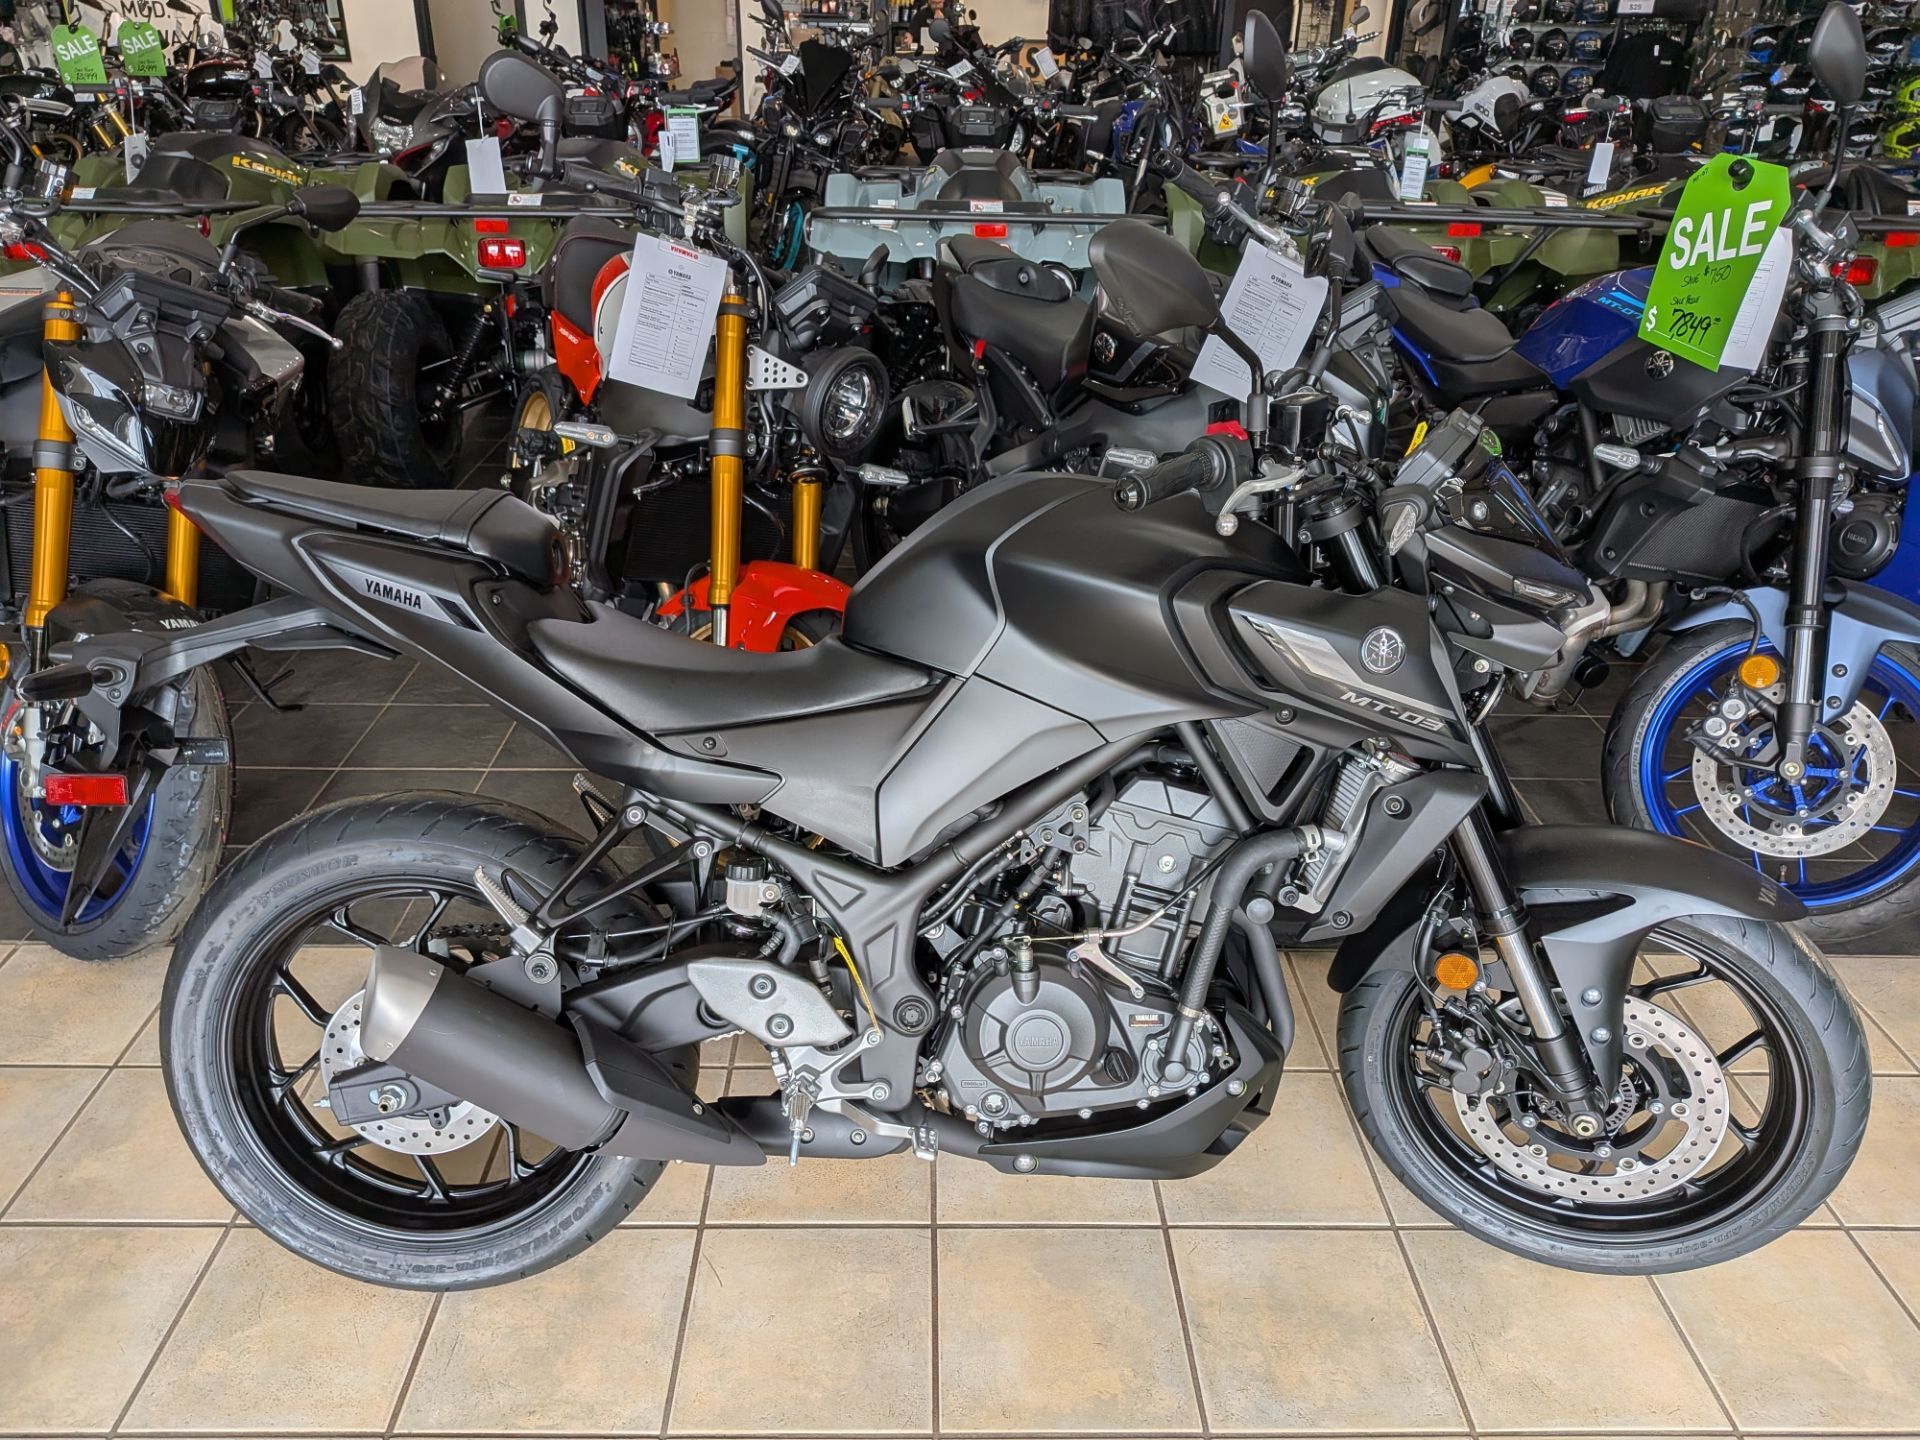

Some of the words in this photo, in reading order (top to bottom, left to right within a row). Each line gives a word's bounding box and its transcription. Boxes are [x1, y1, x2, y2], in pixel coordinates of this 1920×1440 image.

[57, 34, 97, 61] SALE
[122, 30, 159, 54] SALE
[231, 155, 304, 187] KODIAK
[1586, 184, 1668, 209] KODIAK
[1670, 200, 1773, 270] SALE
[1645, 305, 1658, 331] $
[365, 578, 422, 609] YAMAHA
[1340, 691, 1446, 732] MT-03
